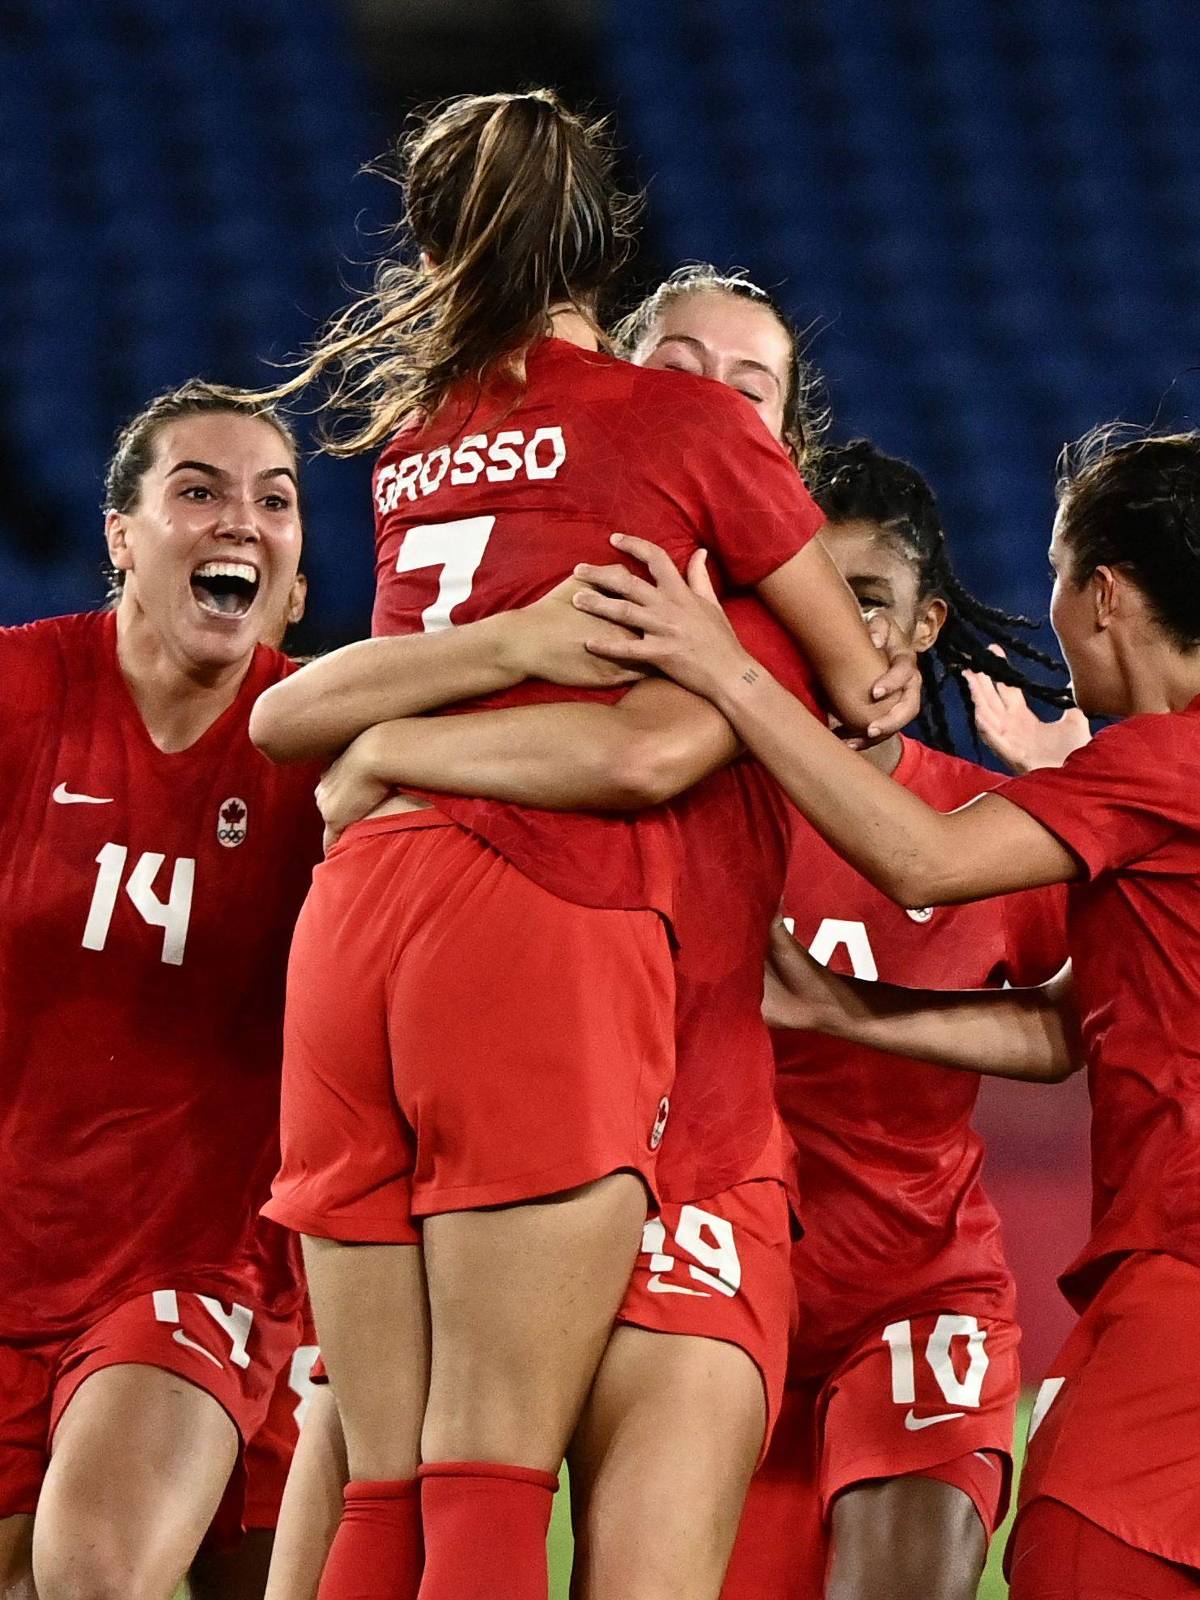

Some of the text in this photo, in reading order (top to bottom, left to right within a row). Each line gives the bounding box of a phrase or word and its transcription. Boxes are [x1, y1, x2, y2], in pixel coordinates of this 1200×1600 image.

[375, 427, 567, 516] GROSSO
[396, 516, 496, 633] 7
[82, 842, 195, 966] 14
[641, 1204, 741, 1298] 19
[882, 1314, 989, 1408] 10
